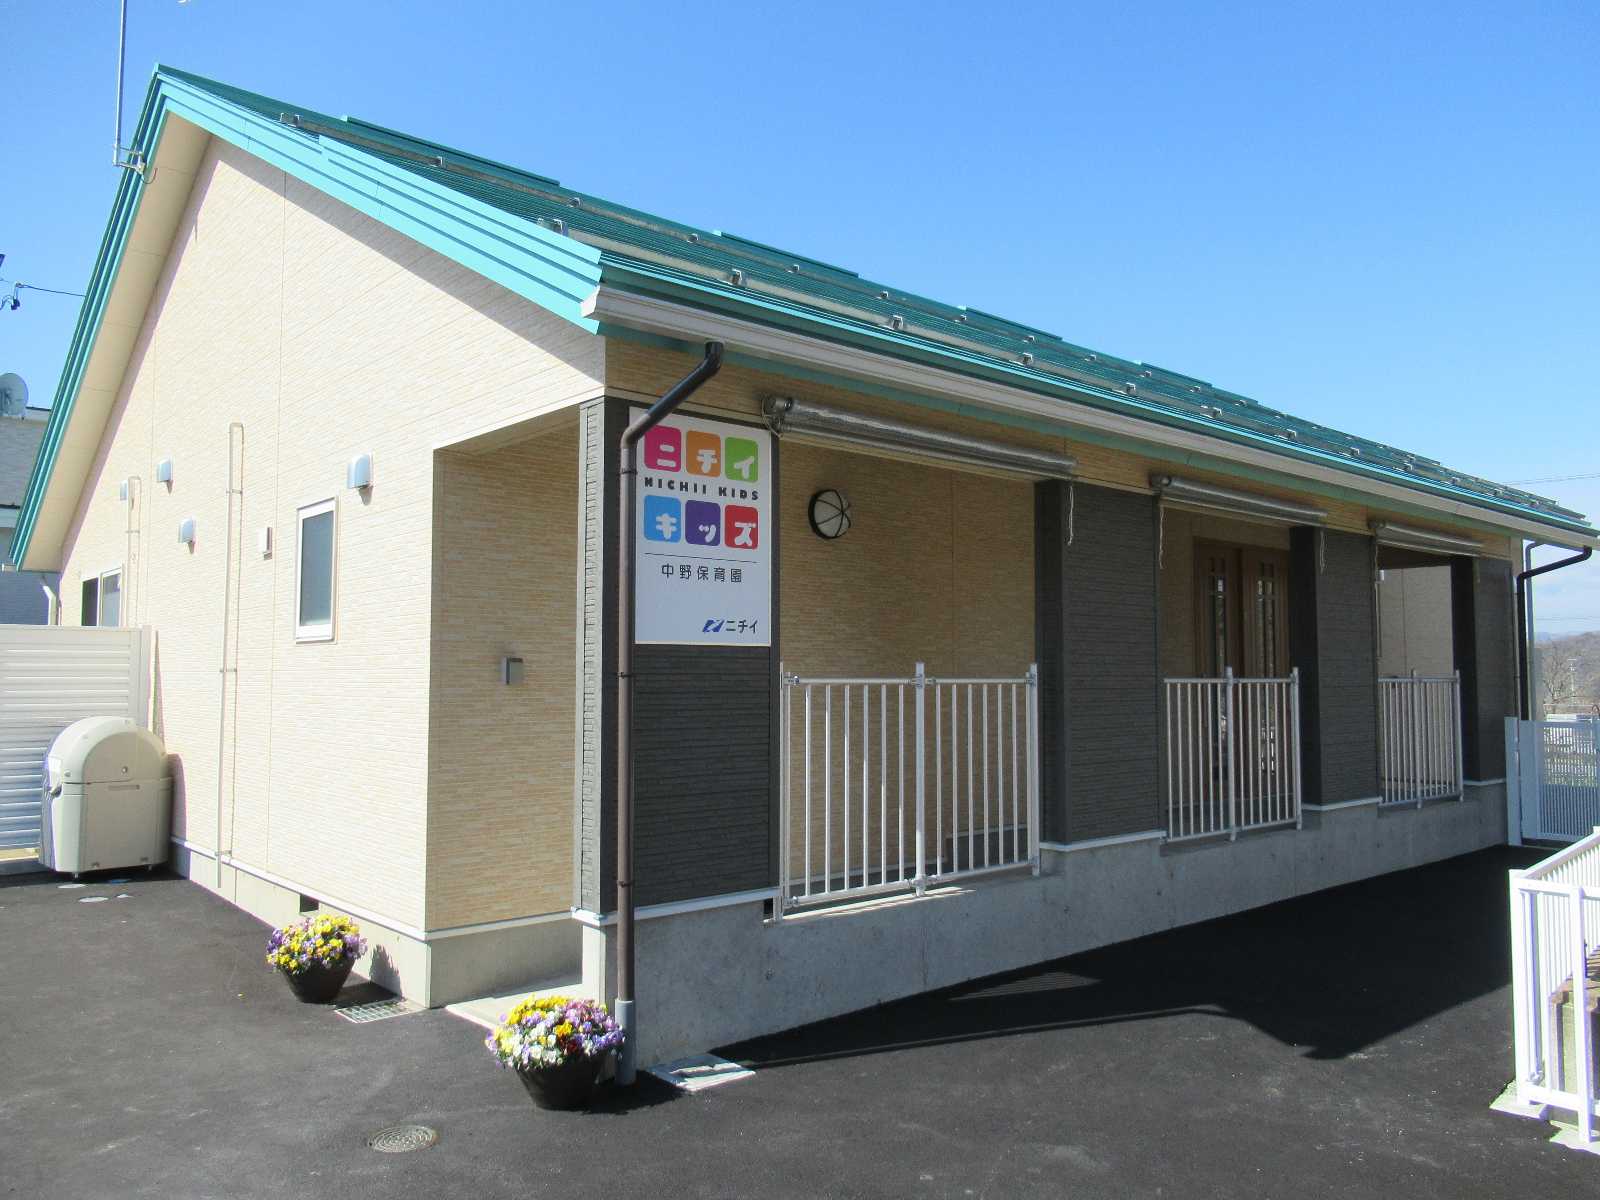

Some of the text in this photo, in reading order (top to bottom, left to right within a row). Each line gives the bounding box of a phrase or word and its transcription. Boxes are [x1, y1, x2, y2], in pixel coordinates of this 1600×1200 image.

[644, 477, 759, 501] NICHII KIDS
[655, 513, 757, 547] キッズ
[661, 562, 743, 583] 中野保育園
[725, 618, 758, 634] ニチイ
